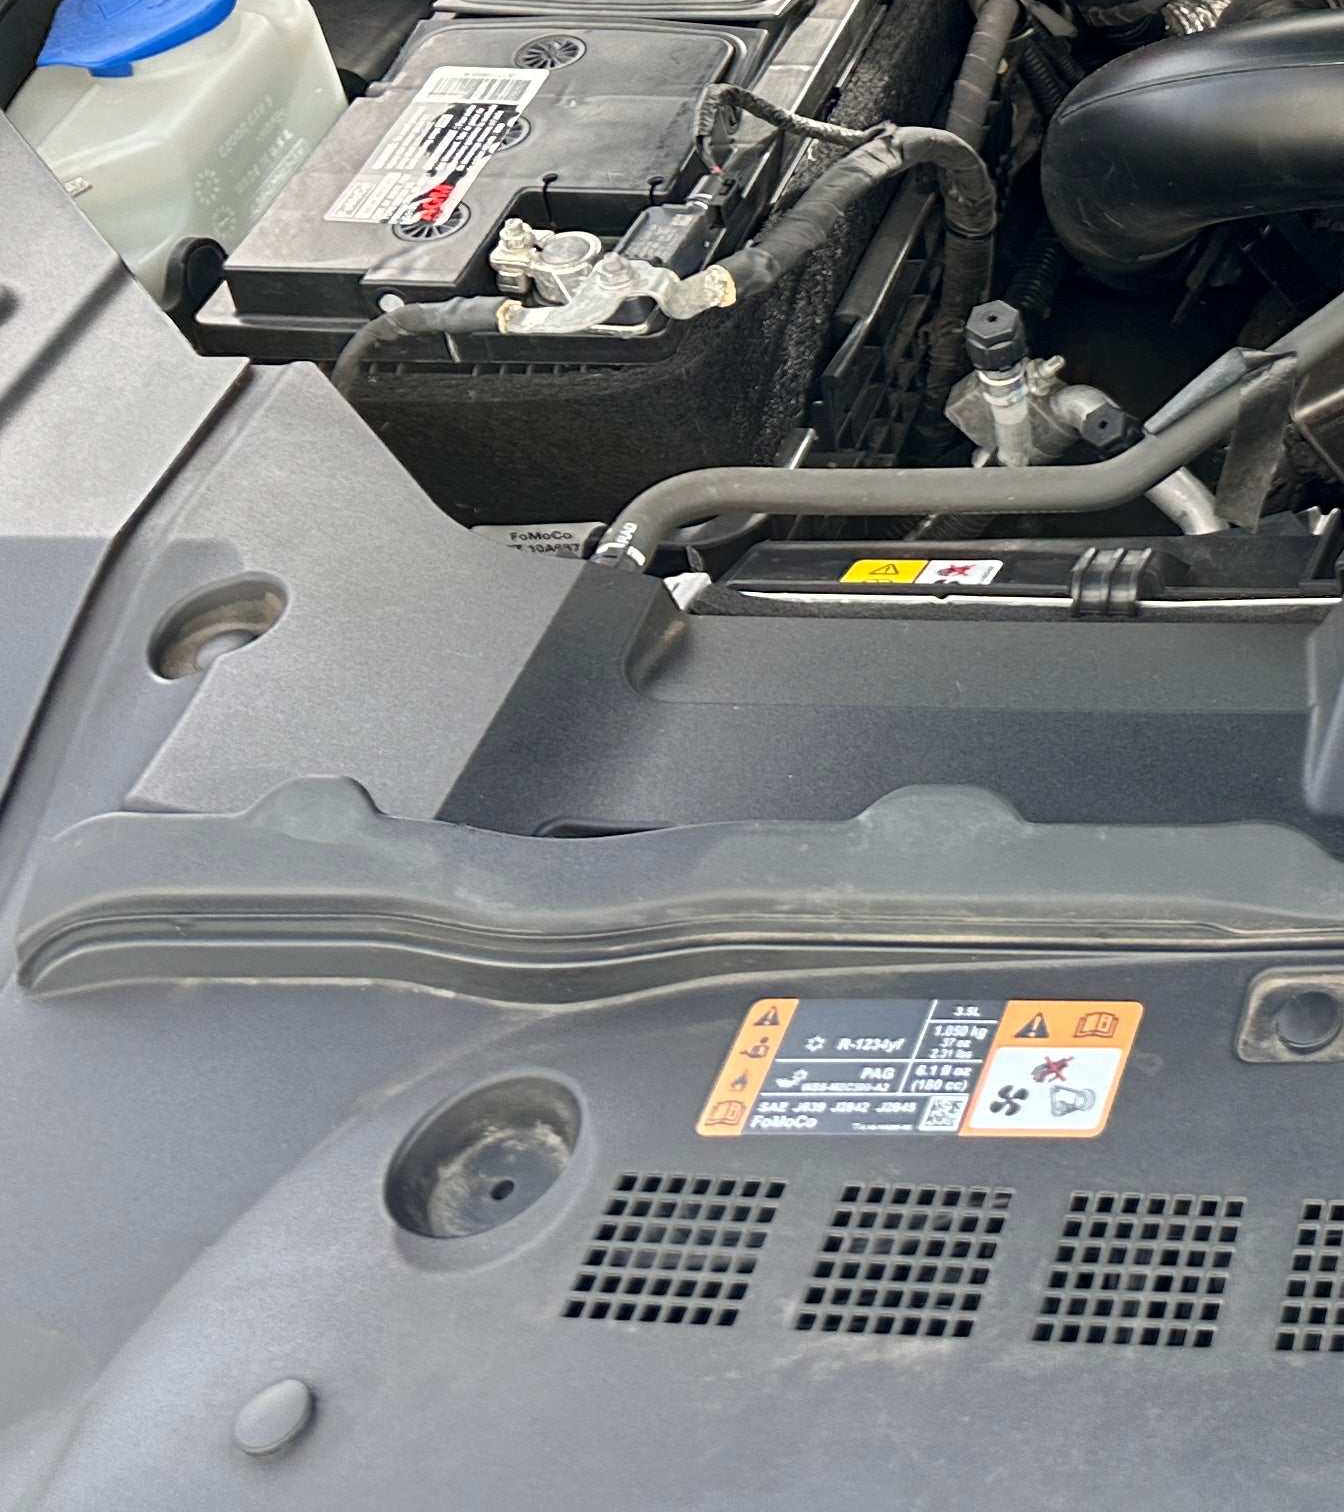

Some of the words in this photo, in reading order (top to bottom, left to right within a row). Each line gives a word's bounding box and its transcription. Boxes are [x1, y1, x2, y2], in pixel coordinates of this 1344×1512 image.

[509, 530, 573, 541] FoMoCo
[968, 1024, 987, 1040] kg
[837, 1037, 905, 1052] R-1234yf
[861, 1067, 895, 1080] PAG
[944, 1078, 968, 1092] cc)
[756, 1101, 787, 1113] SAE
[750, 1115, 817, 1128] FoMoCo
